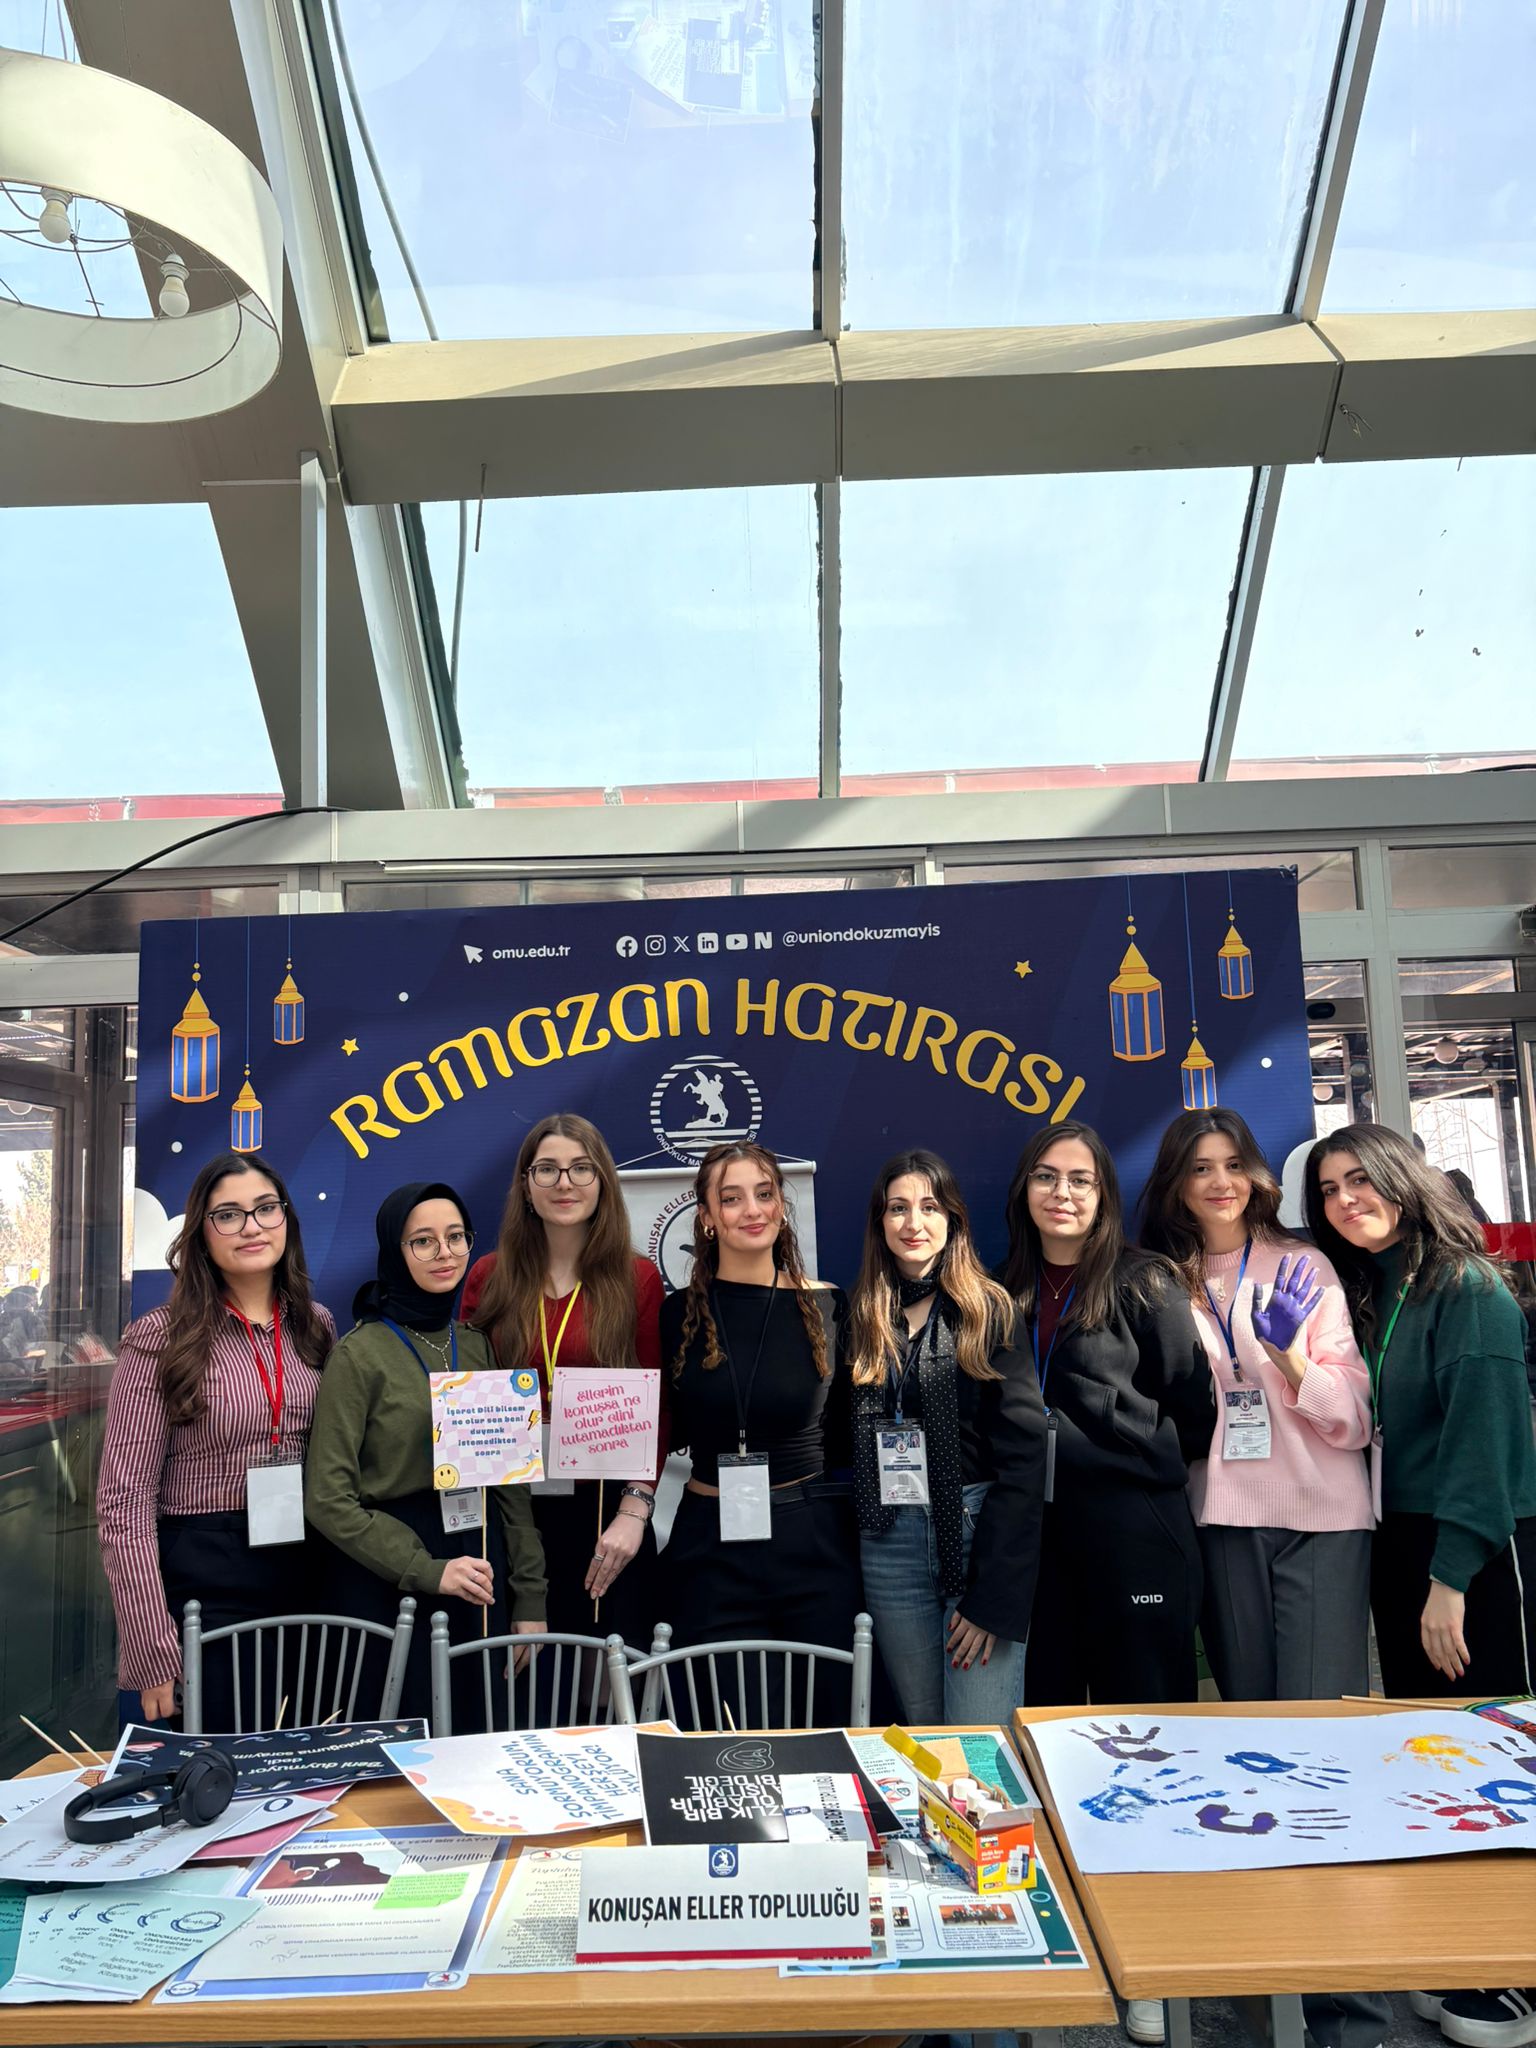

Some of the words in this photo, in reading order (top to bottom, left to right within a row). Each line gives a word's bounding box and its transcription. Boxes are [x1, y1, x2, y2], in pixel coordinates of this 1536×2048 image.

[782, 923, 941, 948] @uniondokuzmayis
[492, 944, 571, 960] omu.edu.tr
[648, 1213, 667, 1265] ONUŞAN
[663, 1190, 696, 1214] ELLER
[574, 1415, 604, 1430] olur
[1131, 1594, 1164, 1604] VOID
[496, 1768, 538, 1796] SANA
[581, 1744, 640, 1795] ÖYLÜYOR!
[683, 1808, 723, 1823] BİR
[588, 1896, 682, 1928] KONUŞAN
[687, 1894, 743, 1921] ELLER
[749, 1886, 861, 1919] TOPLULUĞU
